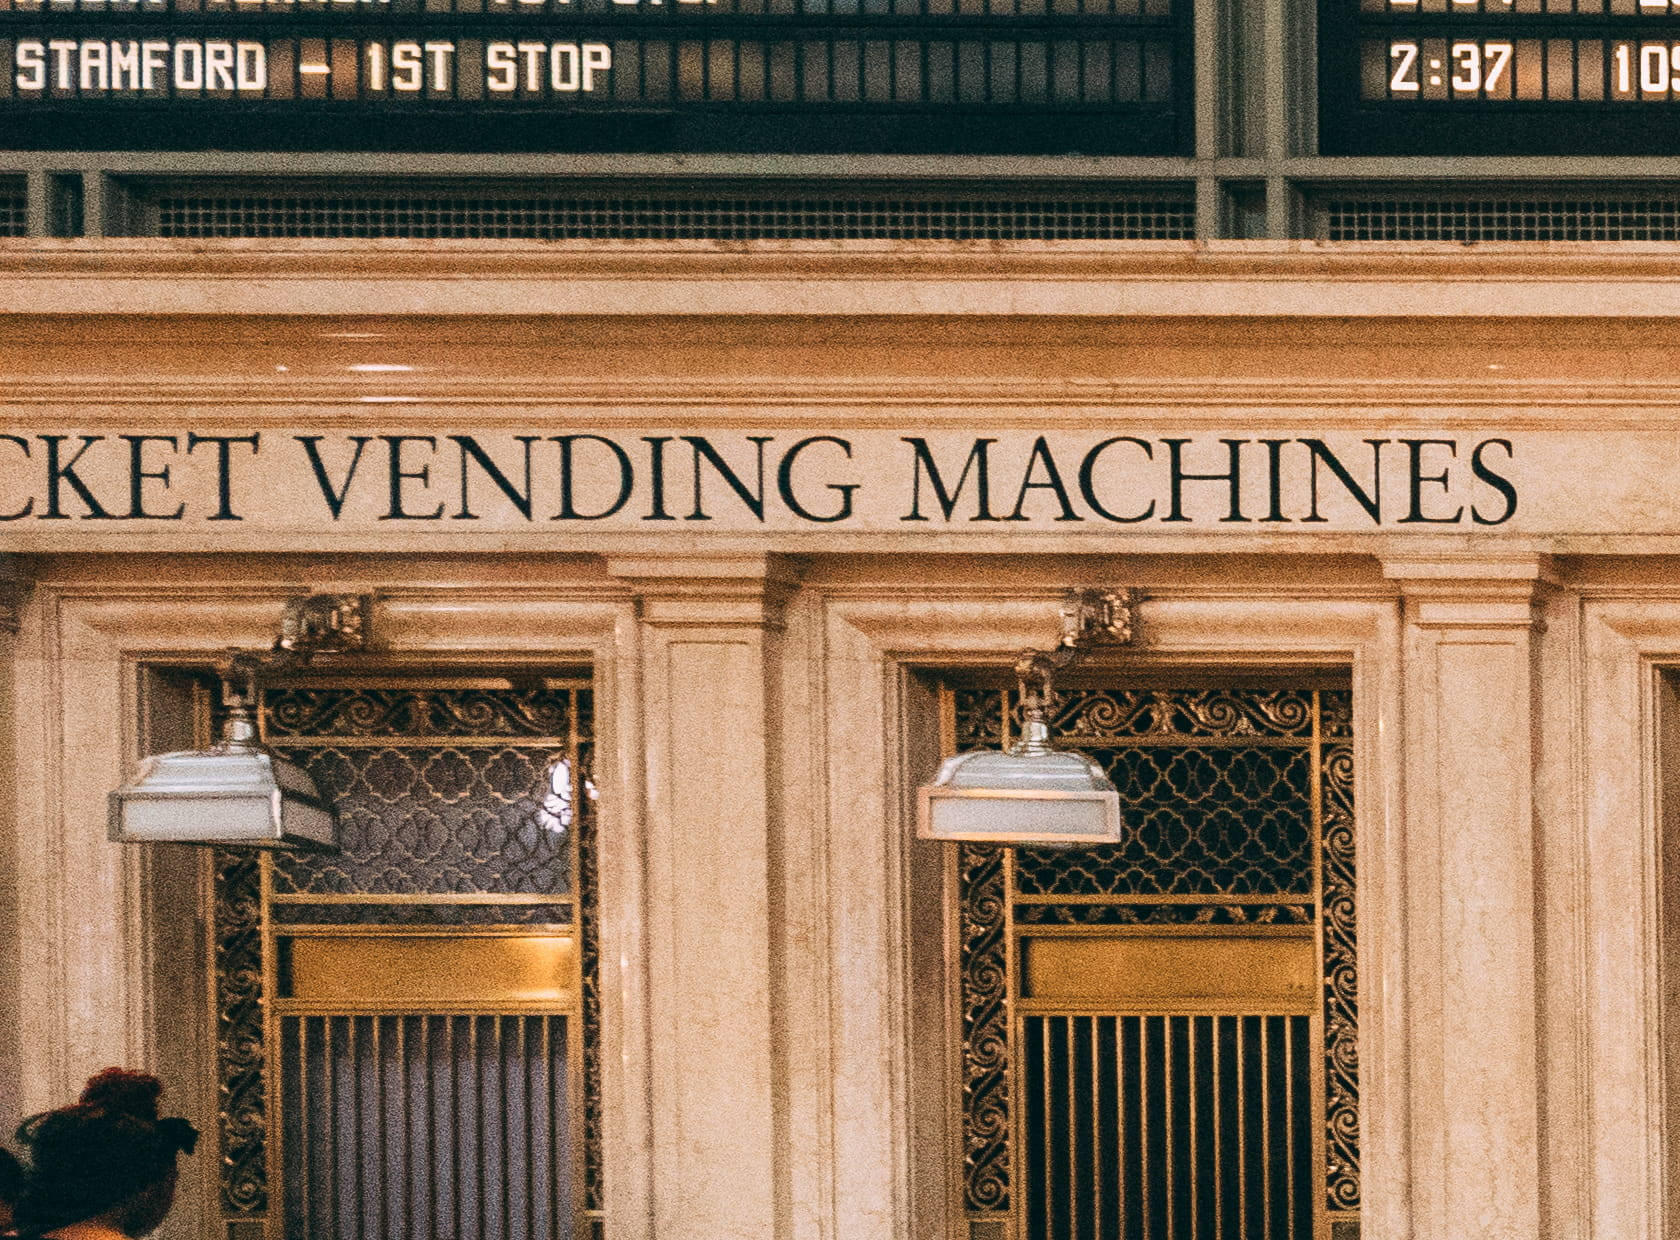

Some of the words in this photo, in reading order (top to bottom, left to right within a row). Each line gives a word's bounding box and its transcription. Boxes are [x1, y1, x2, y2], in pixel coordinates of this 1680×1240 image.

[17, 42, 265, 91] STAMFORD
[368, 43, 454, 91] 1ST
[488, 43, 611, 92] STOP
[1391, 44, 1511, 92] 2:37
[296, 435, 861, 522] VENDING
[902, 437, 1518, 524] MACHINES
